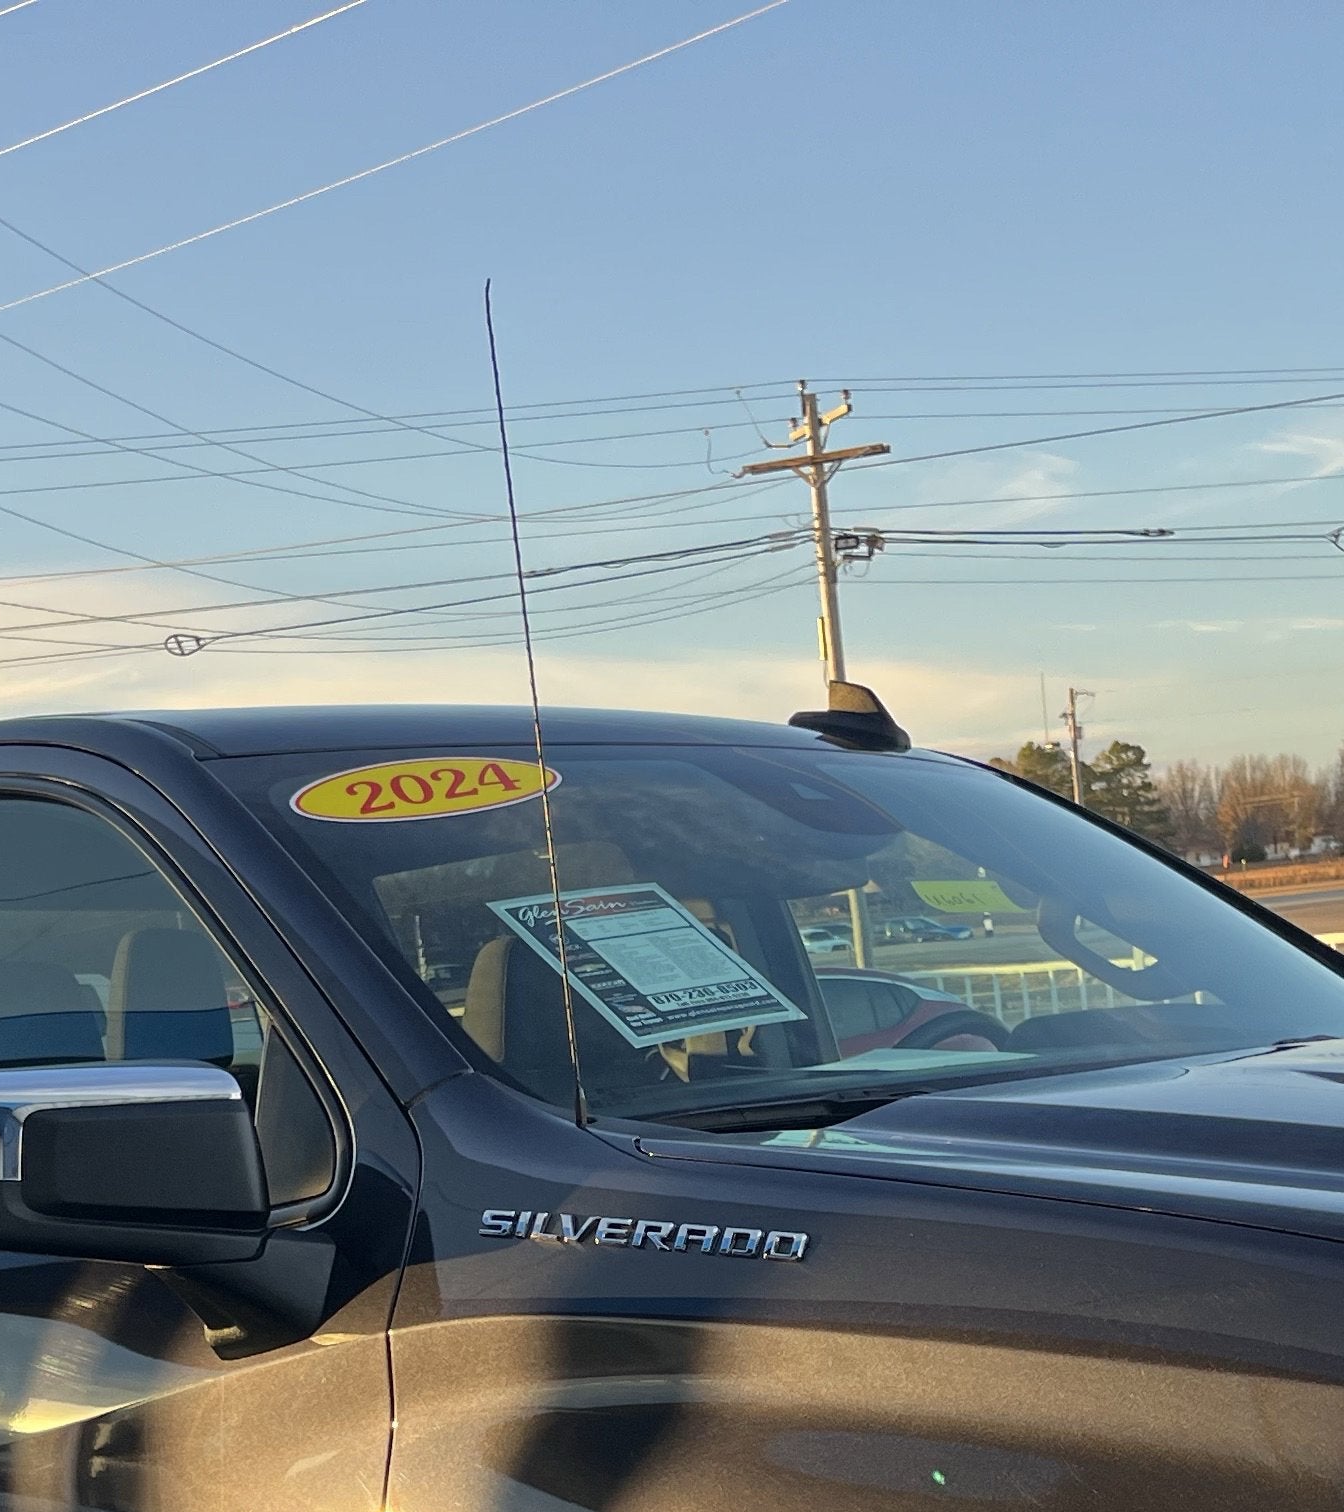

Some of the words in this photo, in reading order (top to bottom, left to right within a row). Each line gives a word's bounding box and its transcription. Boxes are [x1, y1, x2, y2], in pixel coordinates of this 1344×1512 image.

[346, 763, 522, 815] 2024
[565, 899, 627, 915] Sain
[479, 1209, 811, 1262] SILVERADO
